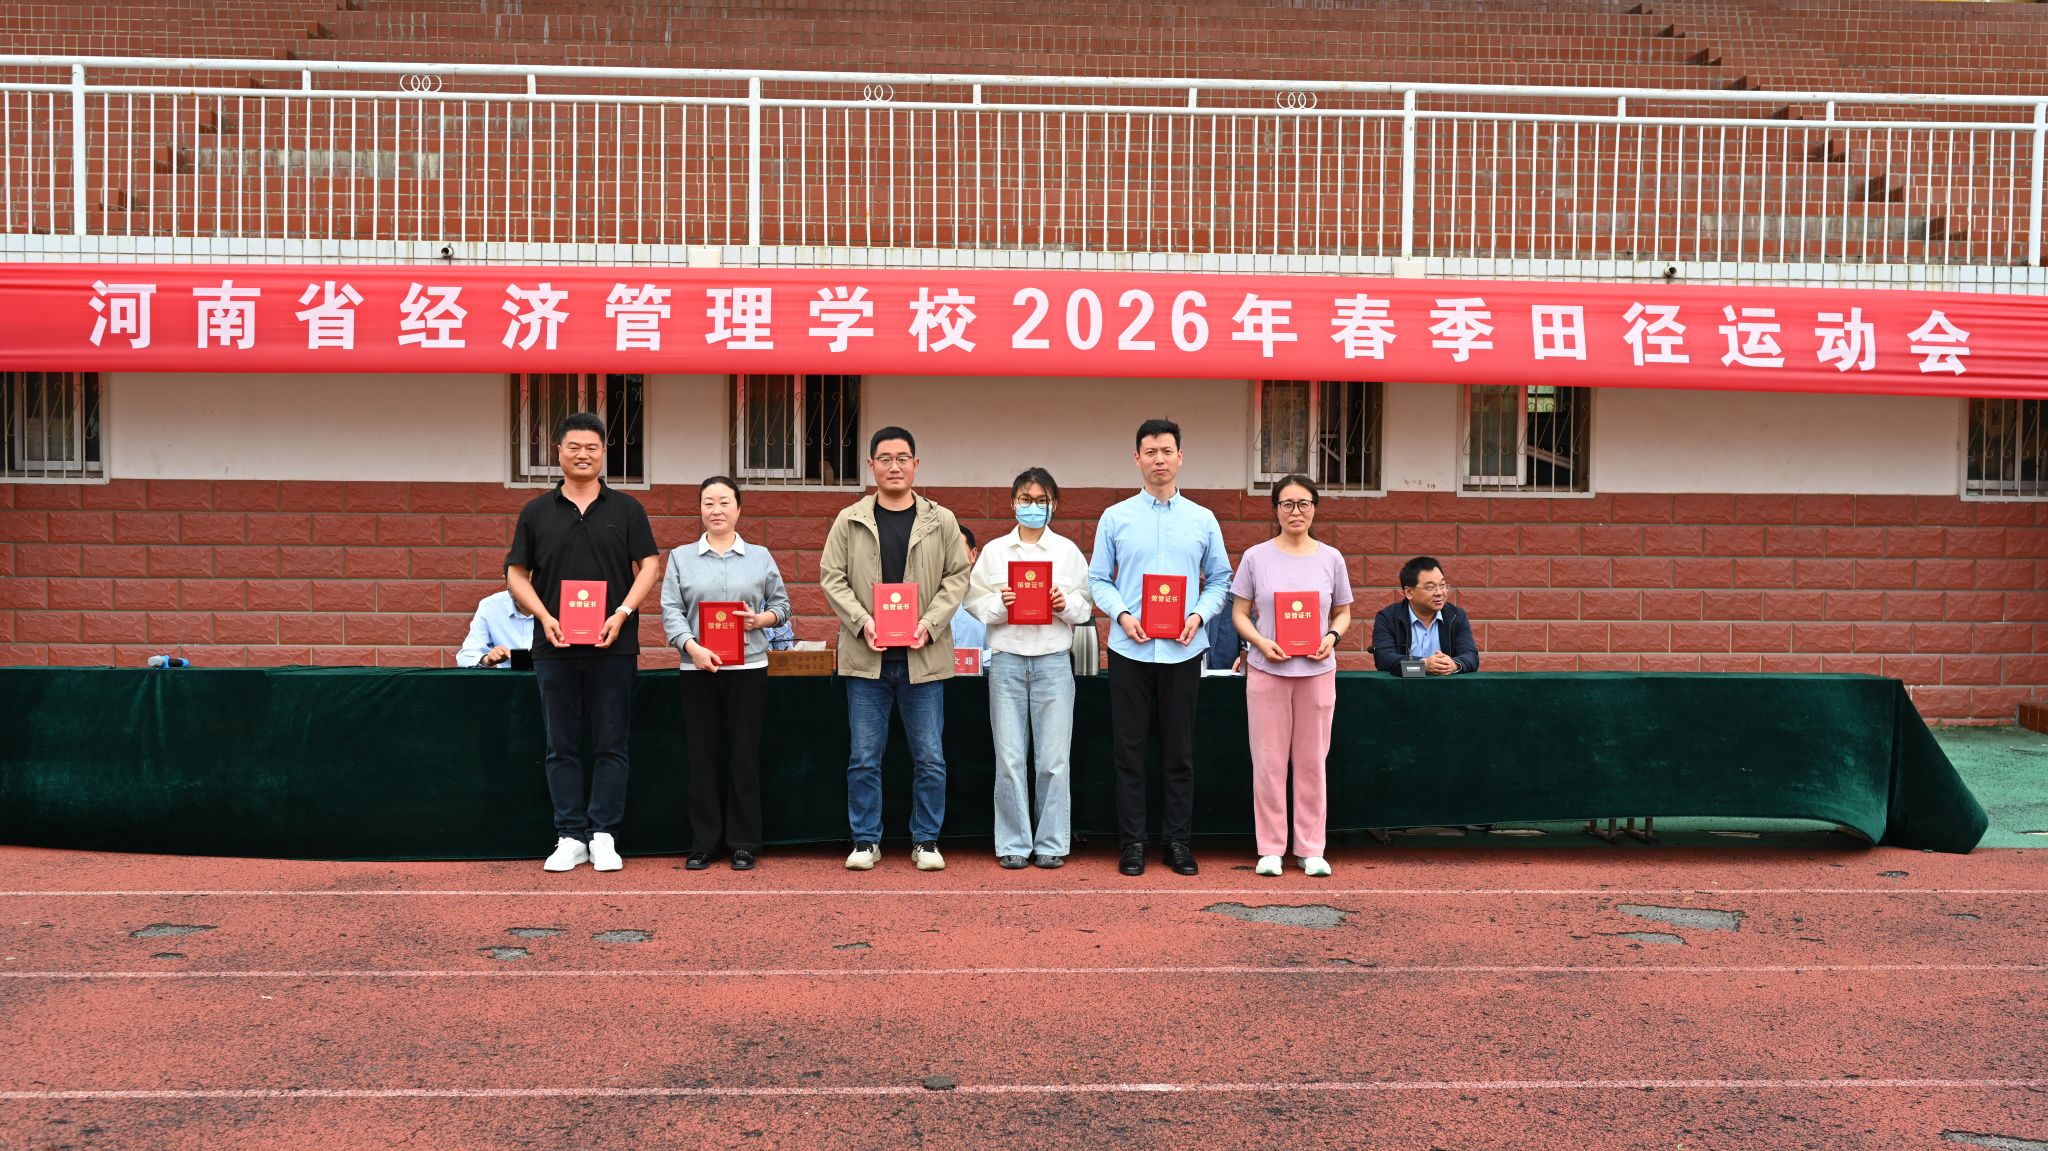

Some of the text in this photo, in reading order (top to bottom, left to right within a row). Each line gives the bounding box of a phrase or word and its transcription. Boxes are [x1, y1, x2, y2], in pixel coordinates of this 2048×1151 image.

[88, 279, 1971, 376] 河南省经济管理学校2026年春季田径运动会
